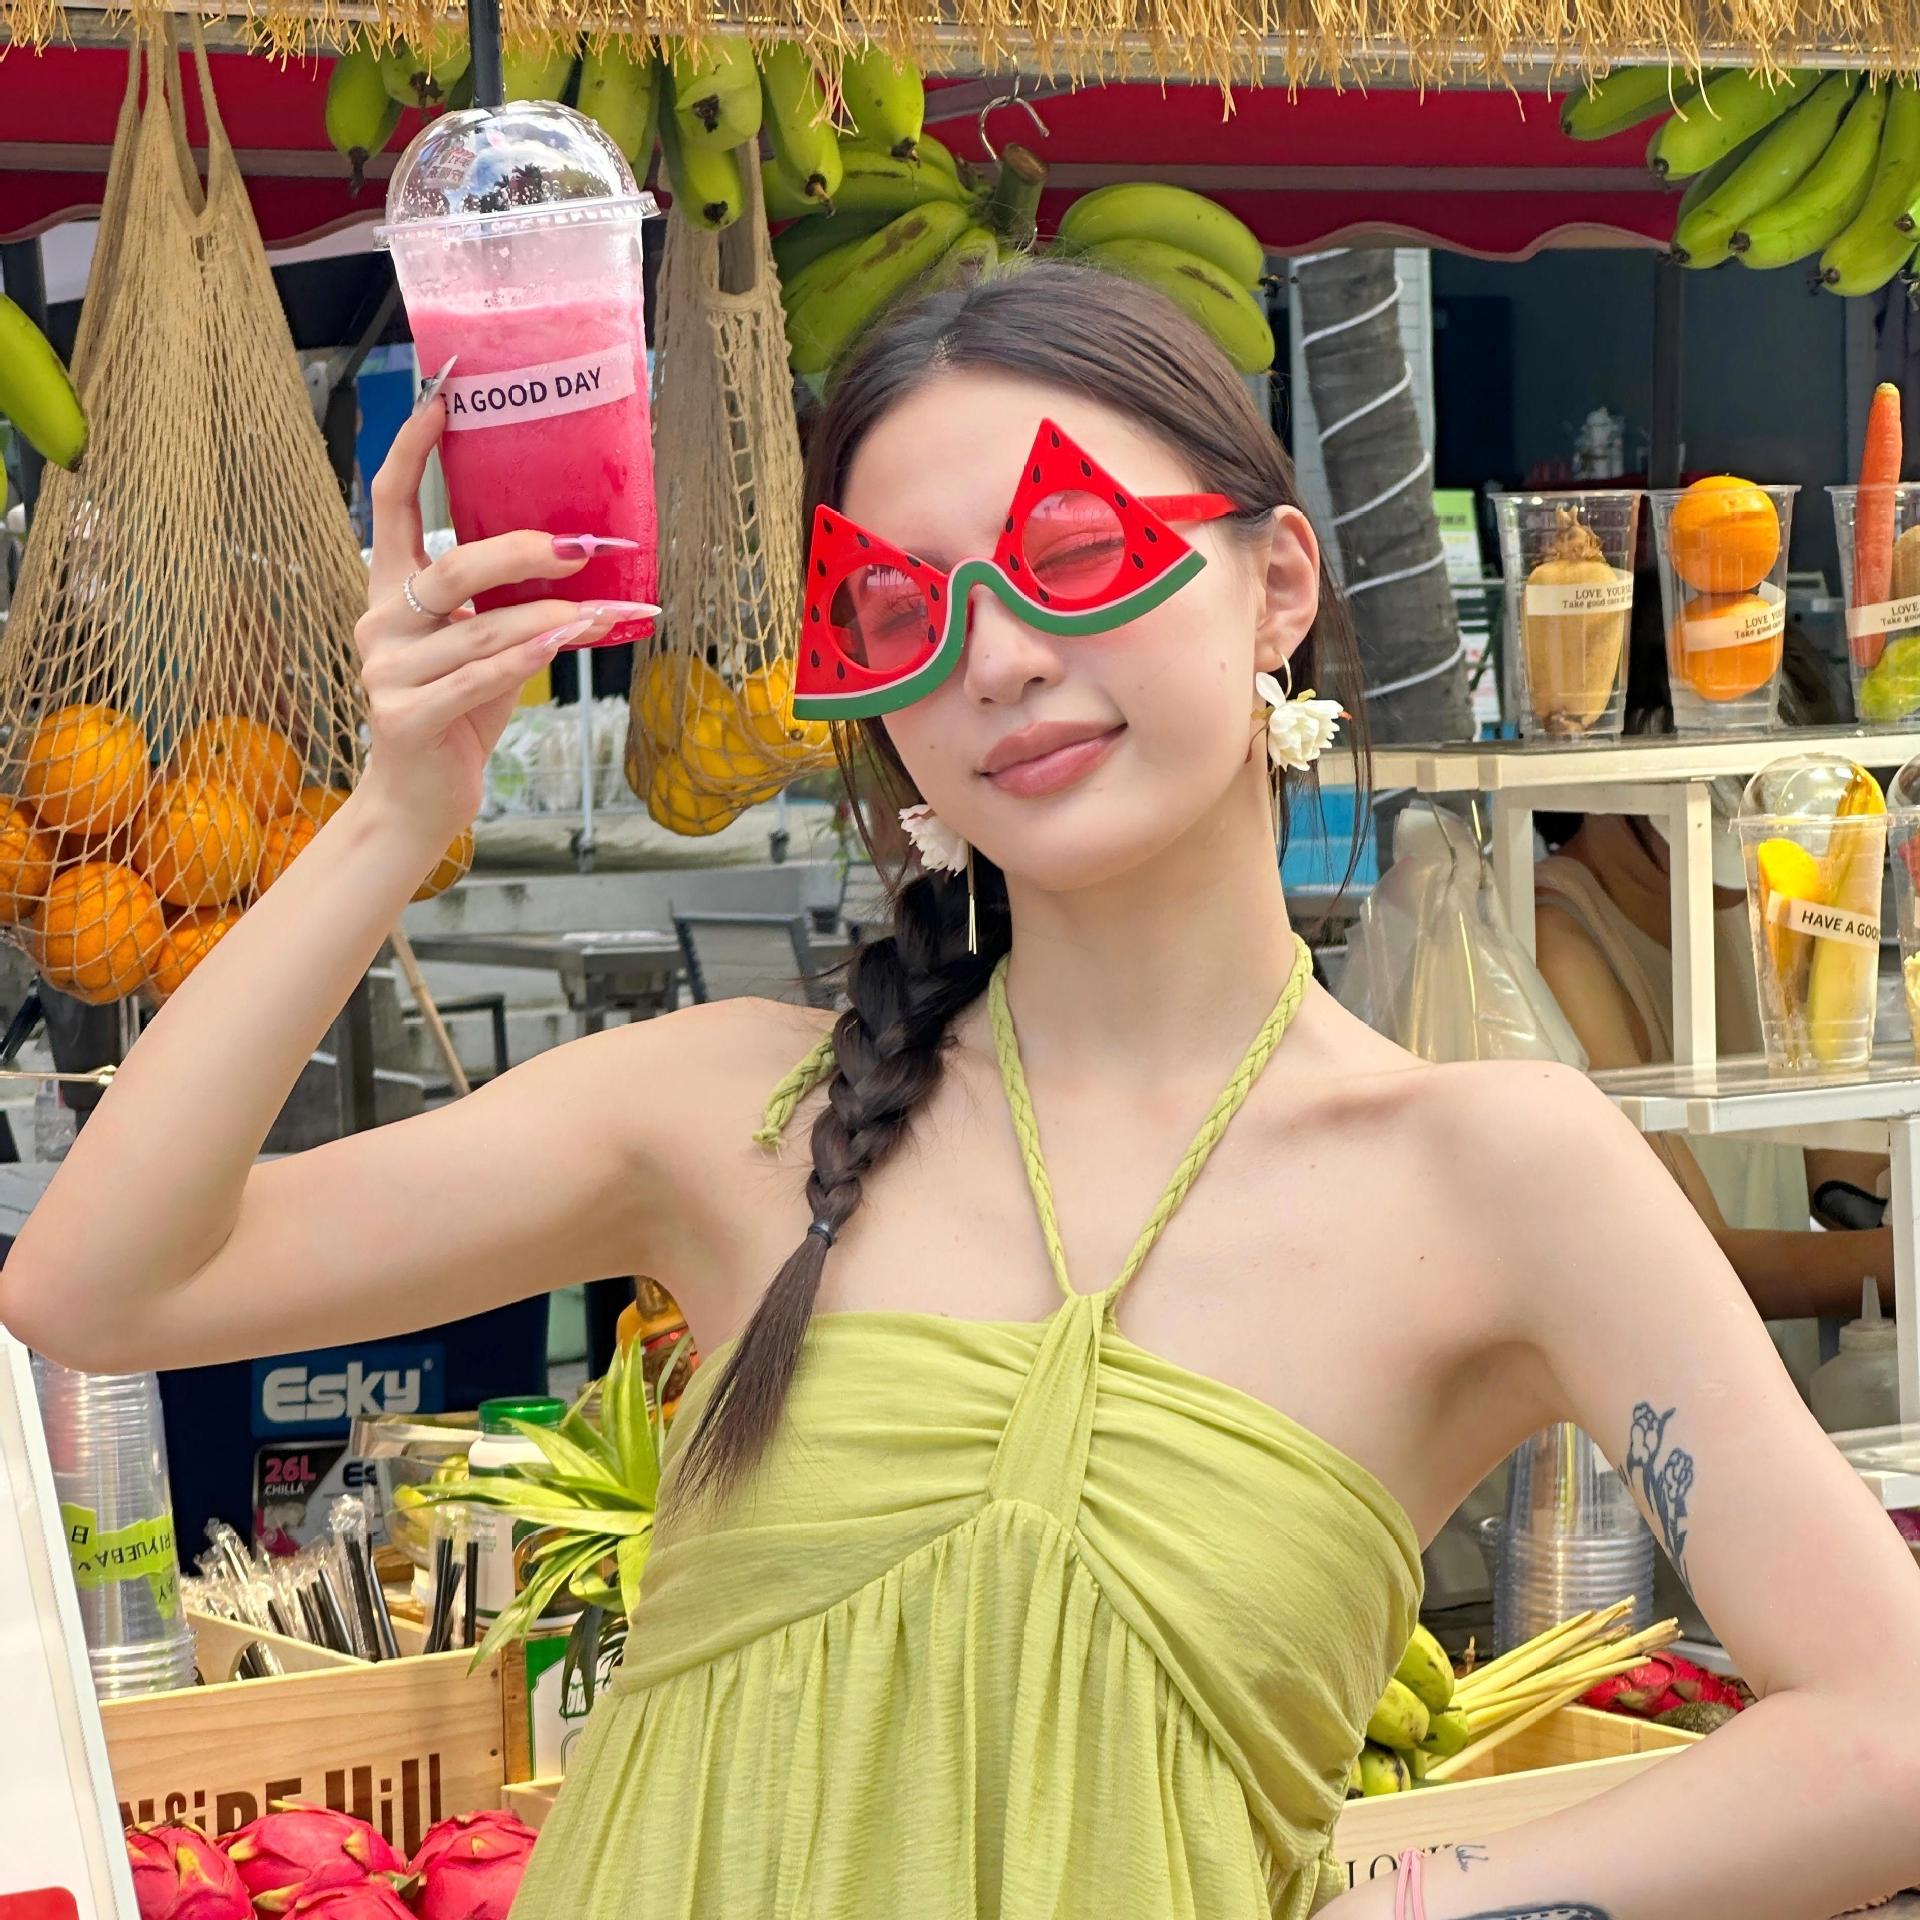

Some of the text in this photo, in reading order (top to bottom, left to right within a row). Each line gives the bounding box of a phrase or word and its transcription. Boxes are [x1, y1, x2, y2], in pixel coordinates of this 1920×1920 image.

[453, 392, 467, 414] A
[470, 381, 547, 413] GOOD
[555, 366, 601, 398] DAY
[1575, 588, 1602, 600] LOVE
[1562, 600, 1584, 609] Take
[1586, 598, 1605, 609] good
[1891, 601, 1919, 616] LOVE
[1745, 614, 1769, 628] LOVE
[1880, 616, 1902, 626] Take
[1802, 910, 1843, 932] HAVE
[1845, 920, 1854, 934] A
[262, 1361, 420, 1424] Esky
[264, 1455, 317, 1483] 26L
[264, 1483, 305, 1497] CHILLA
